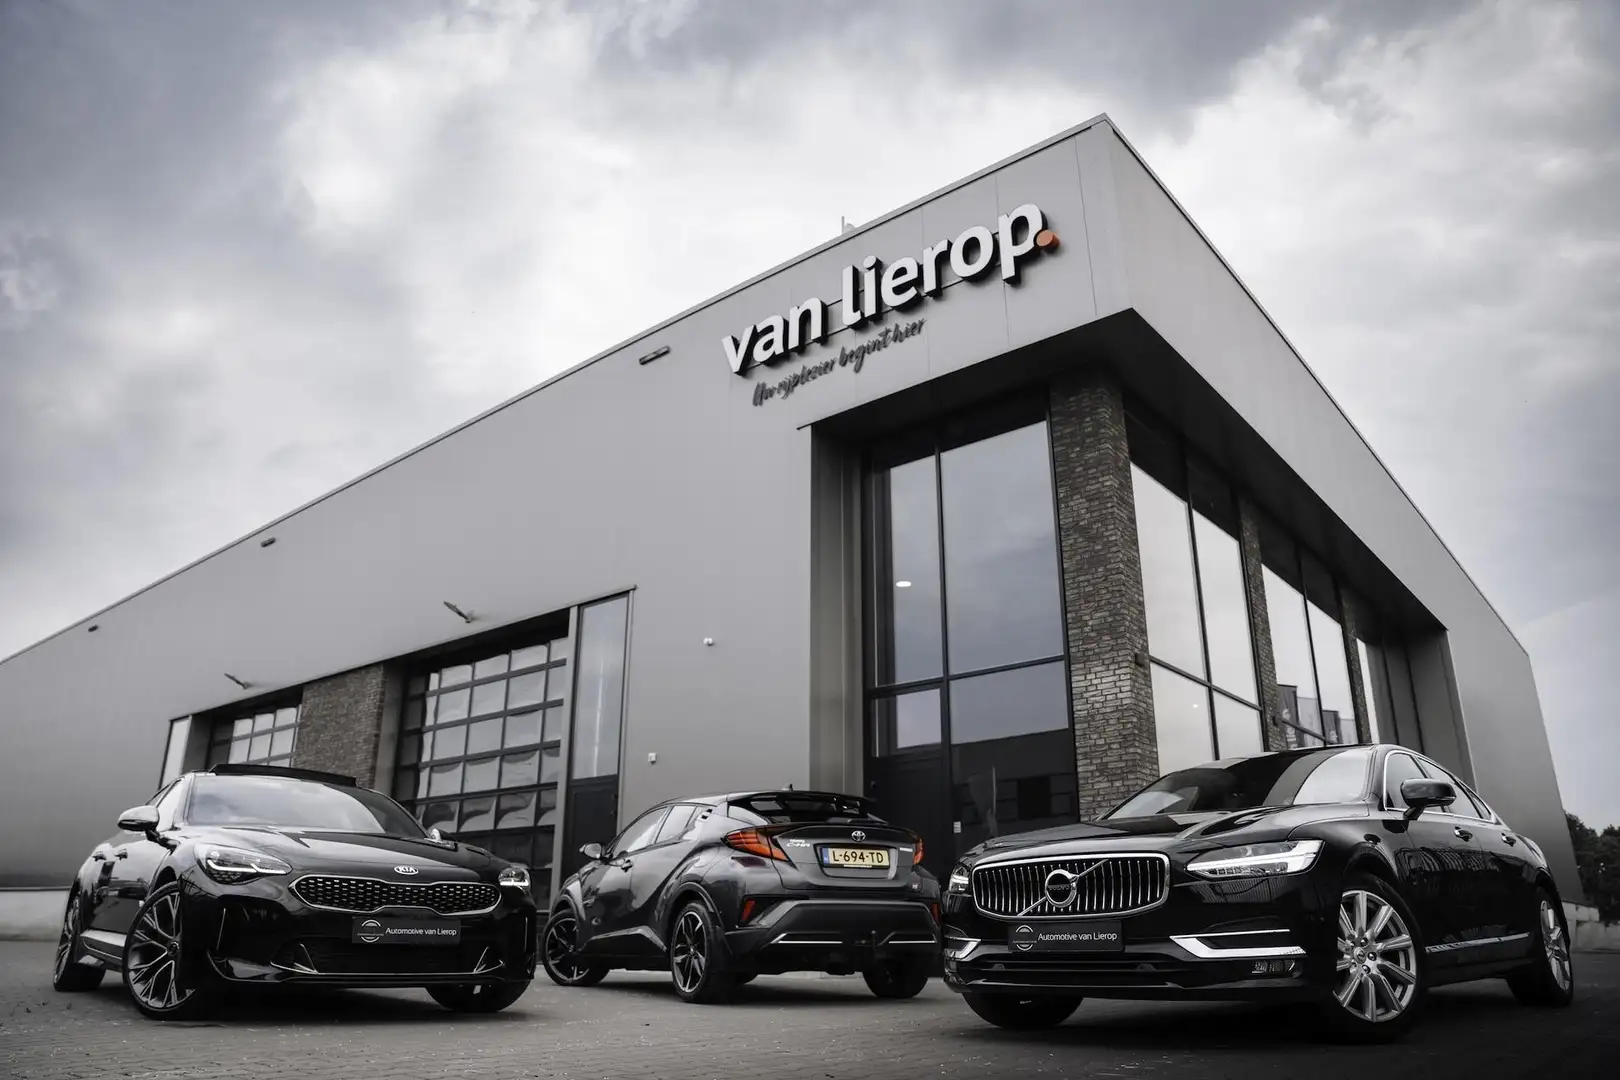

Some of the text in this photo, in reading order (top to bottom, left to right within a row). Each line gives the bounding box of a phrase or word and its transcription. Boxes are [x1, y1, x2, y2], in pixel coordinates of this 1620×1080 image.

[721, 297, 825, 374] van
[838, 326, 892, 374] begint
[891, 318, 928, 343] hier
[832, 850, 884, 863] L-694-TD
[1047, 883, 1070, 891] VOLVO
[385, 927, 424, 935] Automotive
[437, 928, 457, 936] Lierop
[1093, 932, 1118, 941] Lierop
